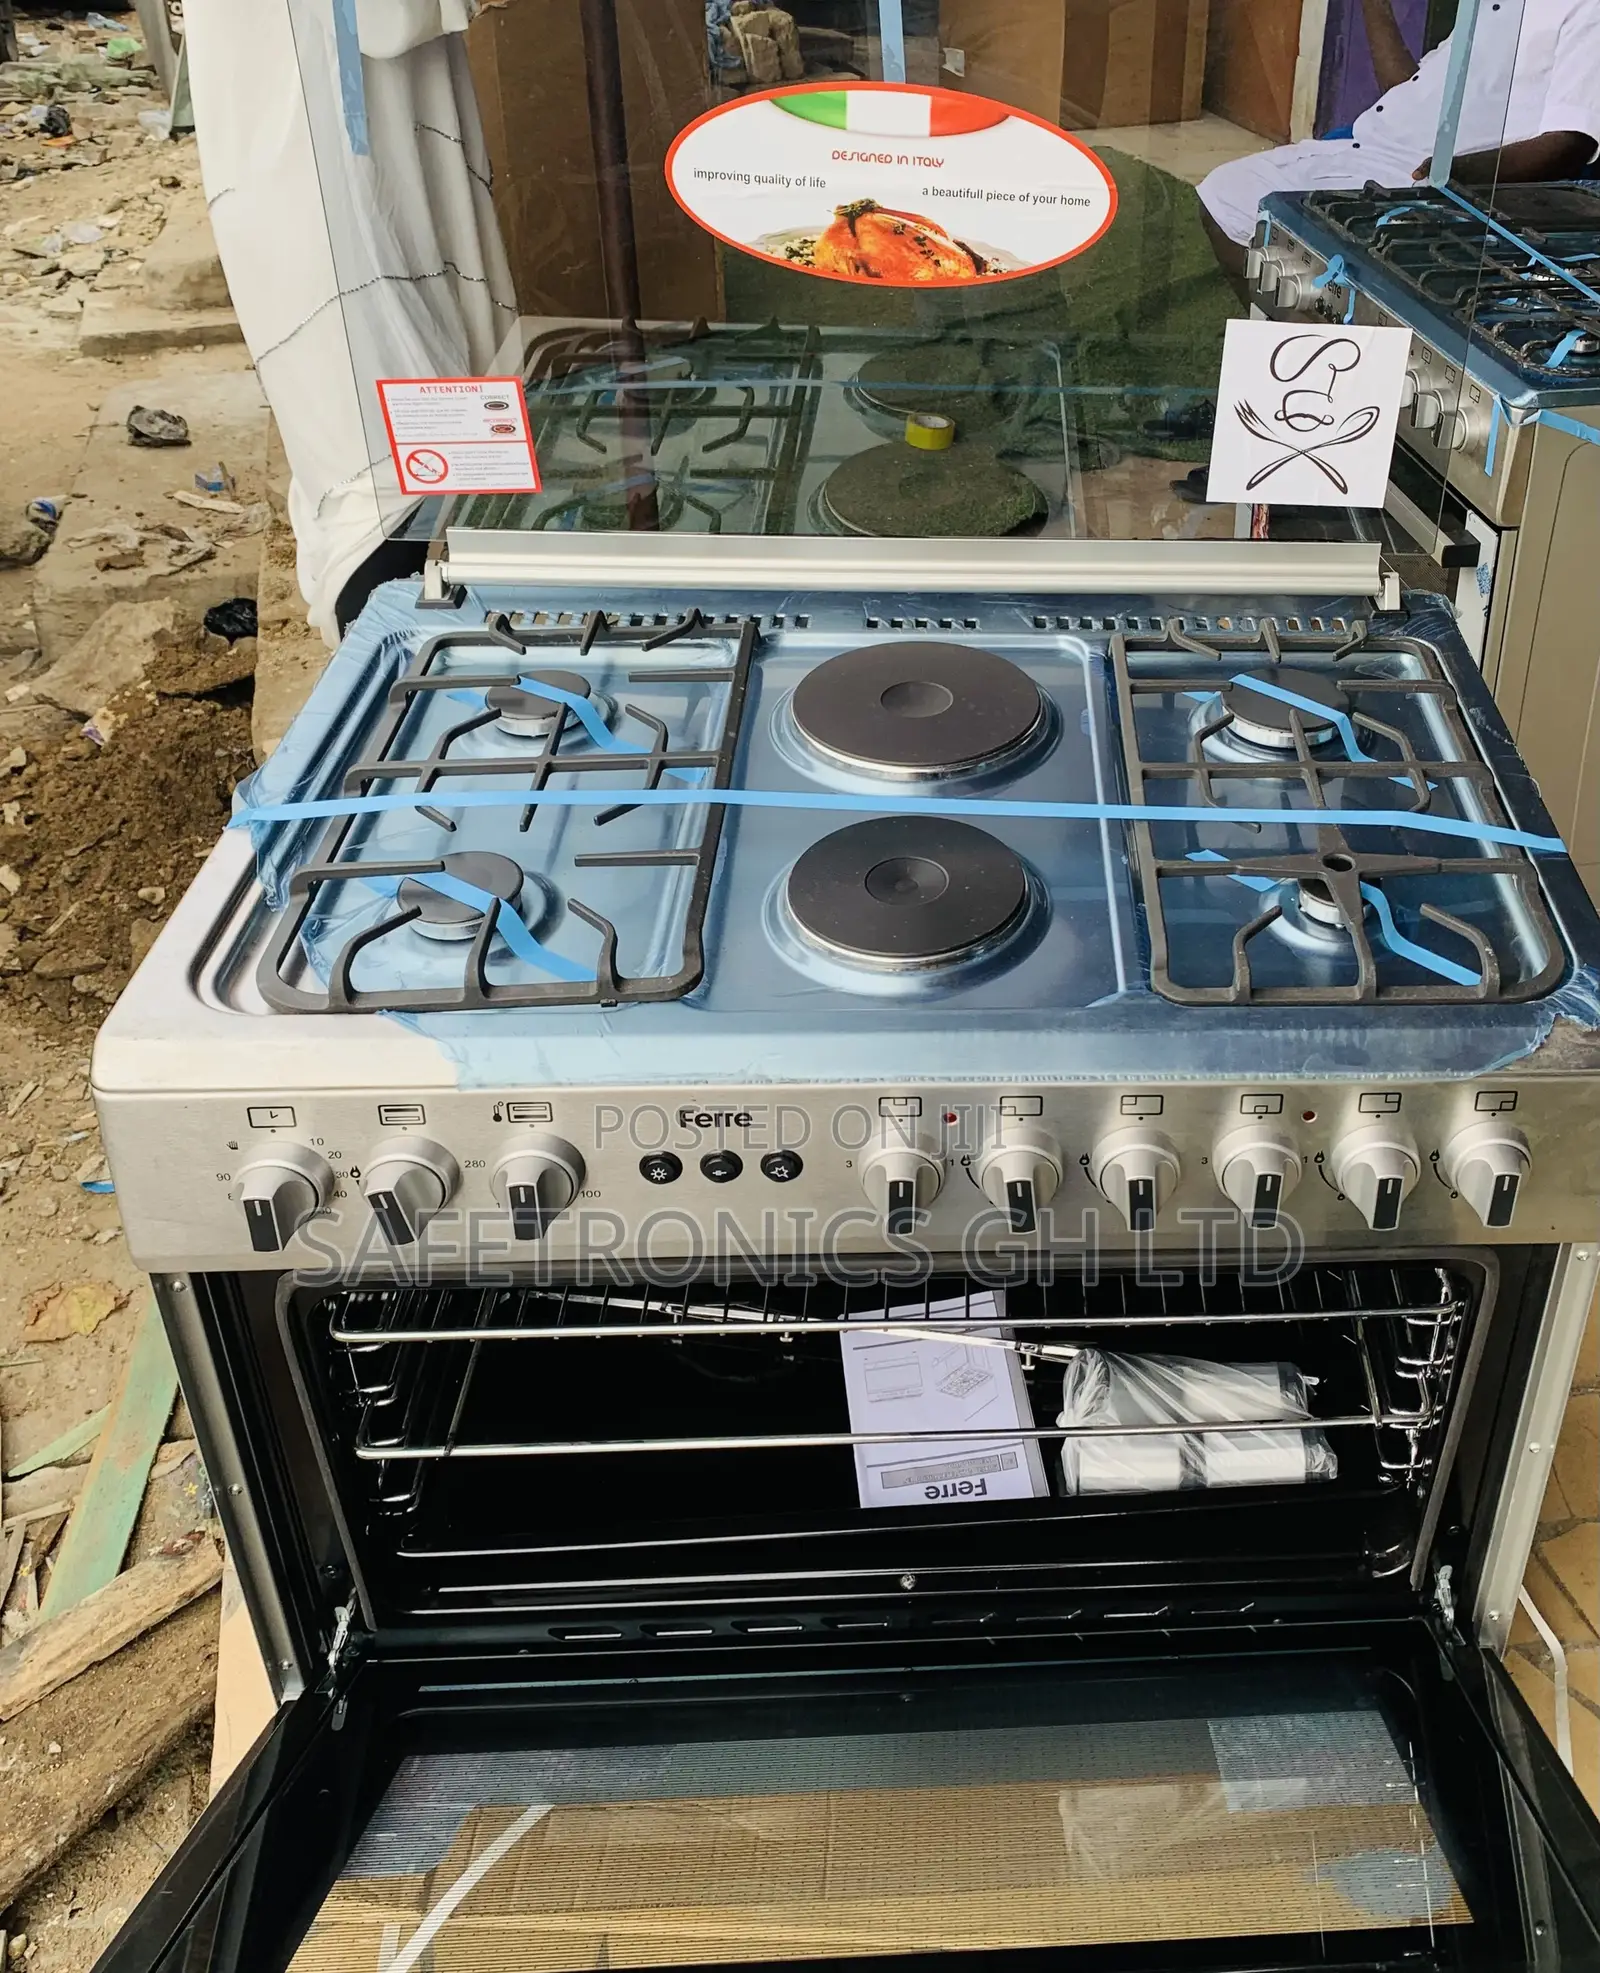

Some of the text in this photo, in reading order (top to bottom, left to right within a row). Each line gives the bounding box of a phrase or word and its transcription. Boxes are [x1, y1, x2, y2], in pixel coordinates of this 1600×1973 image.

[832, 150, 945, 168] DESIGNED IN ITALY
[693, 168, 827, 188] improving quality of life
[922, 186, 1091, 207] a beautifull piece of your home
[419, 385, 484, 394] ATTENTION!
[679, 1109, 753, 1129] Ferre
[309, 1137, 325, 1146] 10
[327, 1151, 342, 1159] 20
[464, 1160, 486, 1169] 280
[845, 1160, 853, 1168] 3
[1201, 1157, 1209, 1165] 3
[216, 1173, 231, 1181] 90
[335, 1171, 349, 1179] 30
[333, 1190, 348, 1198] 40
[580, 1190, 602, 1198] 100
[924, 1478, 988, 1499] Ferre
